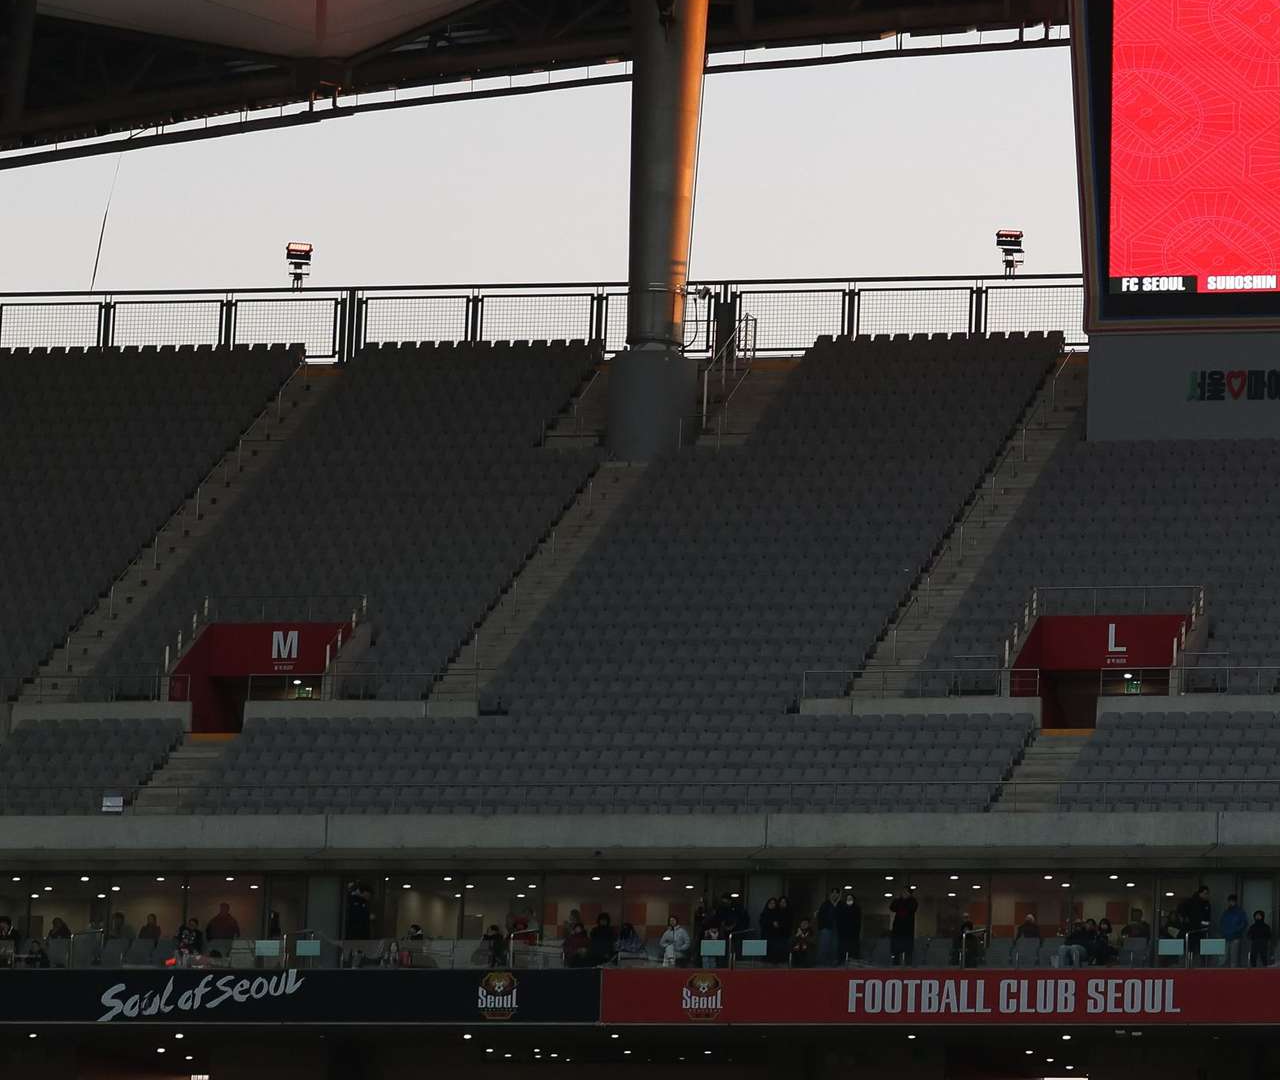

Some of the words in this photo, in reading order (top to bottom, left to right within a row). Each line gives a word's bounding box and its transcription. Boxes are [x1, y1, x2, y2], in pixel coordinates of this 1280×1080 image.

[1122, 278, 1139, 292] FC
[1142, 276, 1186, 291] SEOUL
[1206, 274, 1277, 290] SUHOSHIN
[271, 630, 299, 659] M
[1108, 623, 1127, 652] L
[847, 978, 992, 1014] FOOTBALL
[999, 978, 1077, 1014] CLUB
[1086, 978, 1181, 1013] SEOUL
